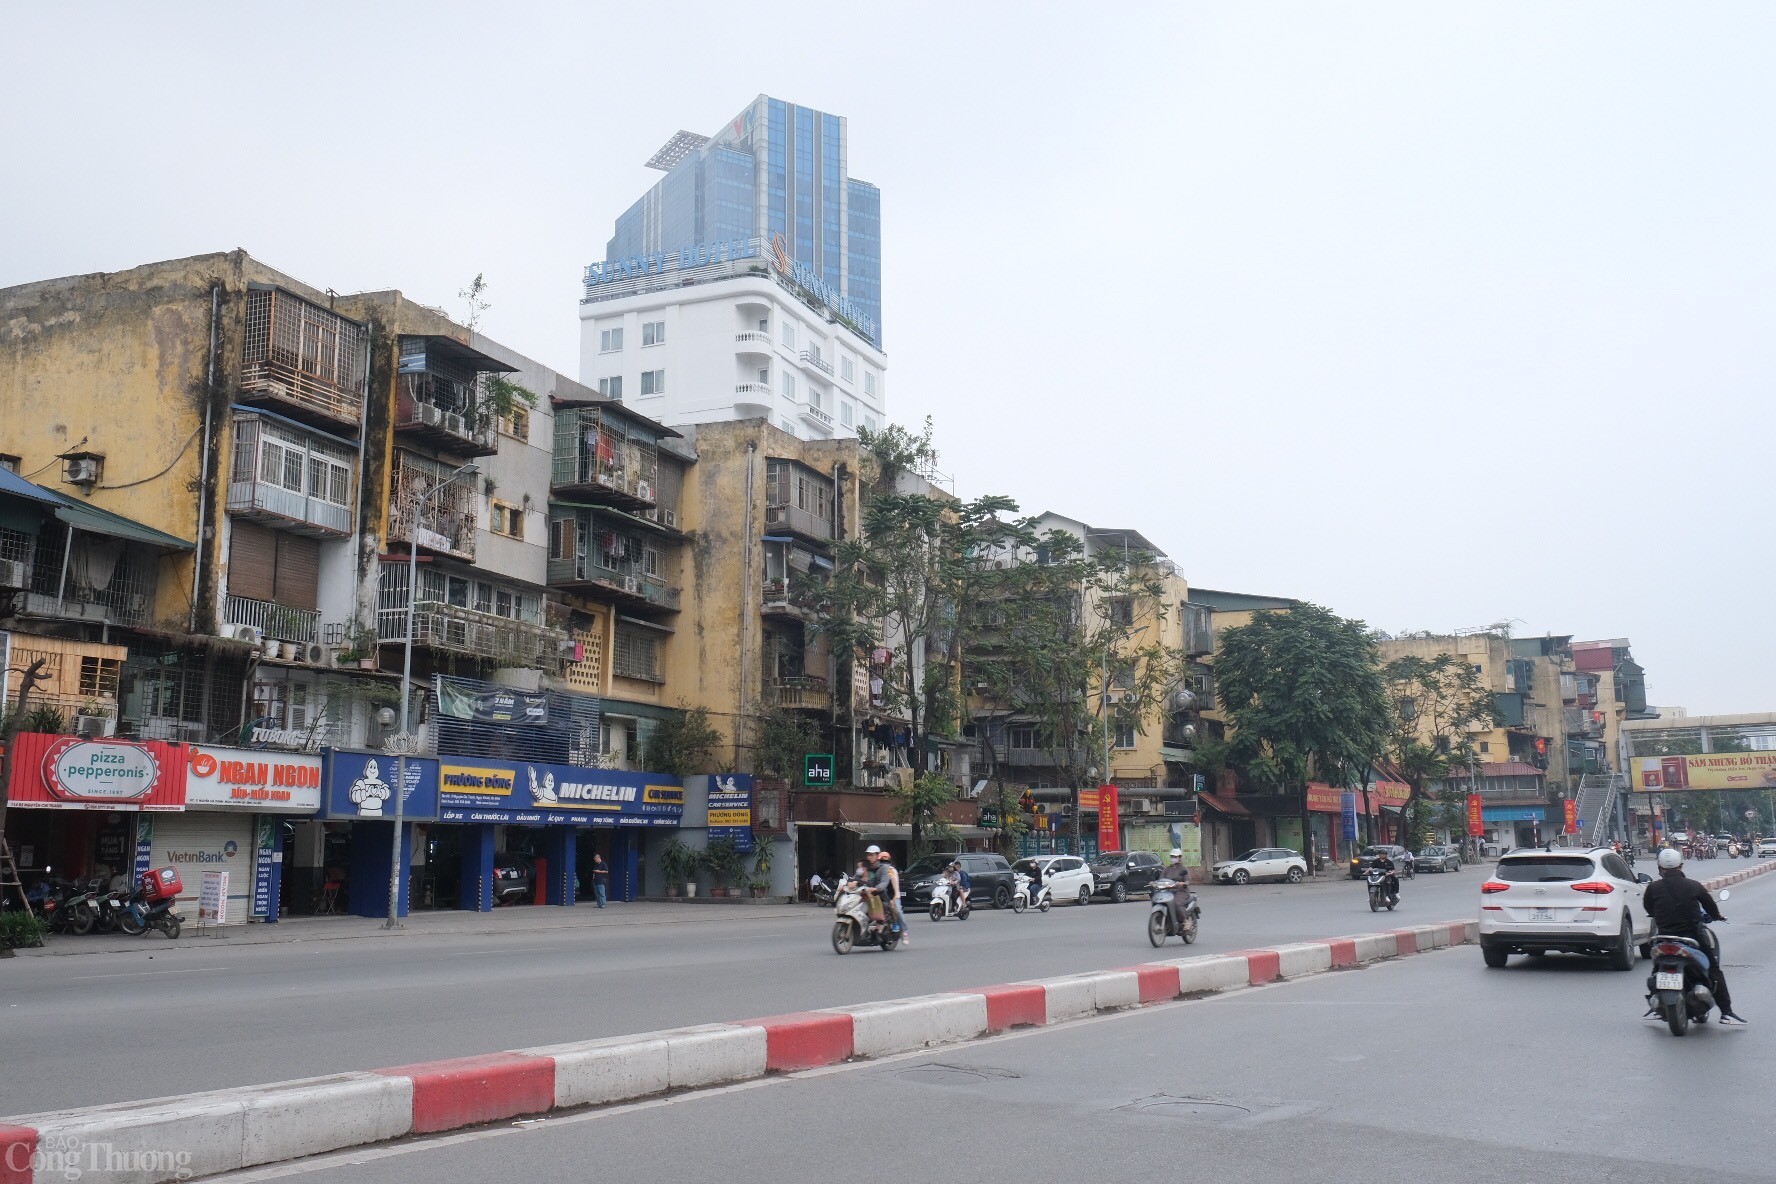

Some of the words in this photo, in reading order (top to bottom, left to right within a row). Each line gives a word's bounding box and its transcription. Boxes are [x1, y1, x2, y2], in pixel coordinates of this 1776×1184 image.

[733, 104, 758, 139] VTV
[587, 251, 668, 286] SUNNY
[678, 237, 758, 270] HOTEL
[90, 750, 125, 765] pizza
[1688, 757, 1707, 768] SÂM
[1708, 757, 1738, 767] NHUNG
[68, 765, 144, 780] pepperonis
[219, 760, 268, 785] NGAN
[273, 764, 320, 788] NGON
[808, 764, 830, 778] aha
[559, 782, 637, 802] MICHELIN
[983, 811, 997, 820] aha
[167, 850, 225, 863] VietinBank
